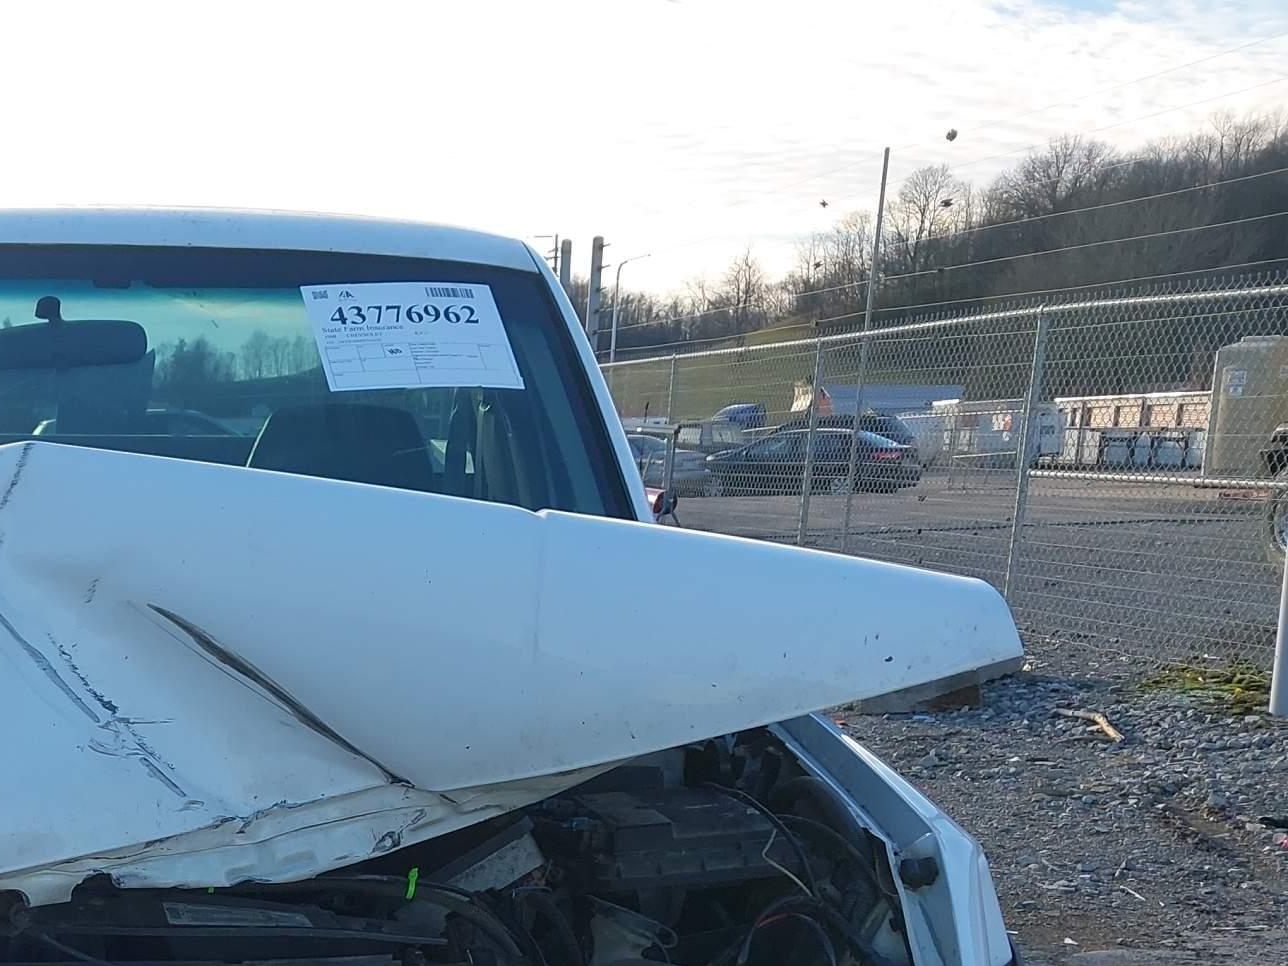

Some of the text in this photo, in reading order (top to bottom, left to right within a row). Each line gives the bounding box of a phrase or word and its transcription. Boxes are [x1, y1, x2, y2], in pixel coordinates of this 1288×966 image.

[330, 304, 480, 325] 43776962
[322, 323, 404, 334] State Farm Insurance
